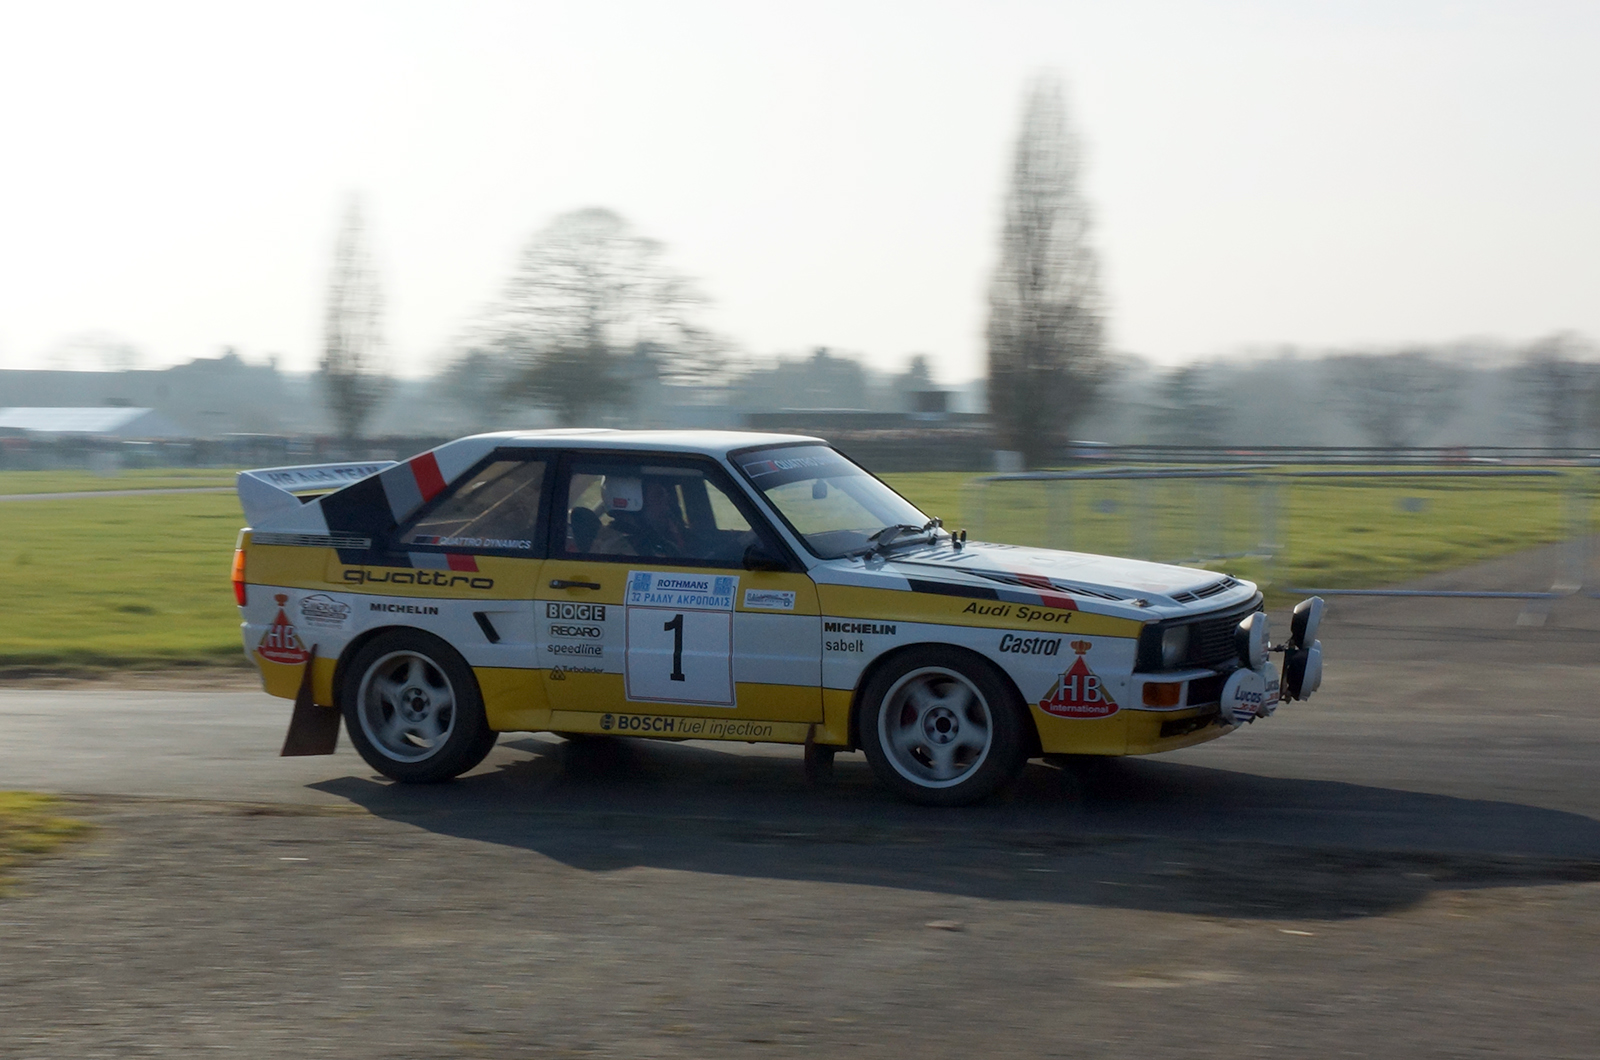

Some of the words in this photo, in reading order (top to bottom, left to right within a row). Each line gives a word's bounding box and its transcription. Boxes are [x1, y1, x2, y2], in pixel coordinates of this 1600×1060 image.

[440, 537, 482, 547] QUATTRO
[483, 538, 531, 549] DYNAMICS
[343, 569, 495, 589] quattro
[657, 579, 709, 590] ROTHMANS
[631, 592, 642, 602] 32
[370, 603, 439, 615] MICHELIN
[547, 603, 605, 621] BOGE
[962, 601, 1012, 617] Audi
[1015, 605, 1073, 624] Sport
[550, 625, 601, 638] RECARO
[824, 621, 897, 635] MICHELIN
[268, 624, 298, 649] HB
[999, 633, 1061, 655] Castrol
[547, 643, 603, 656] speedline
[664, 614, 686, 682] 1
[825, 639, 864, 653] sabelt
[1057, 673, 1104, 703] HB
[617, 715, 674, 732] BOSCH
[677, 718, 706, 735] fuel
[709, 719, 773, 738] injection
